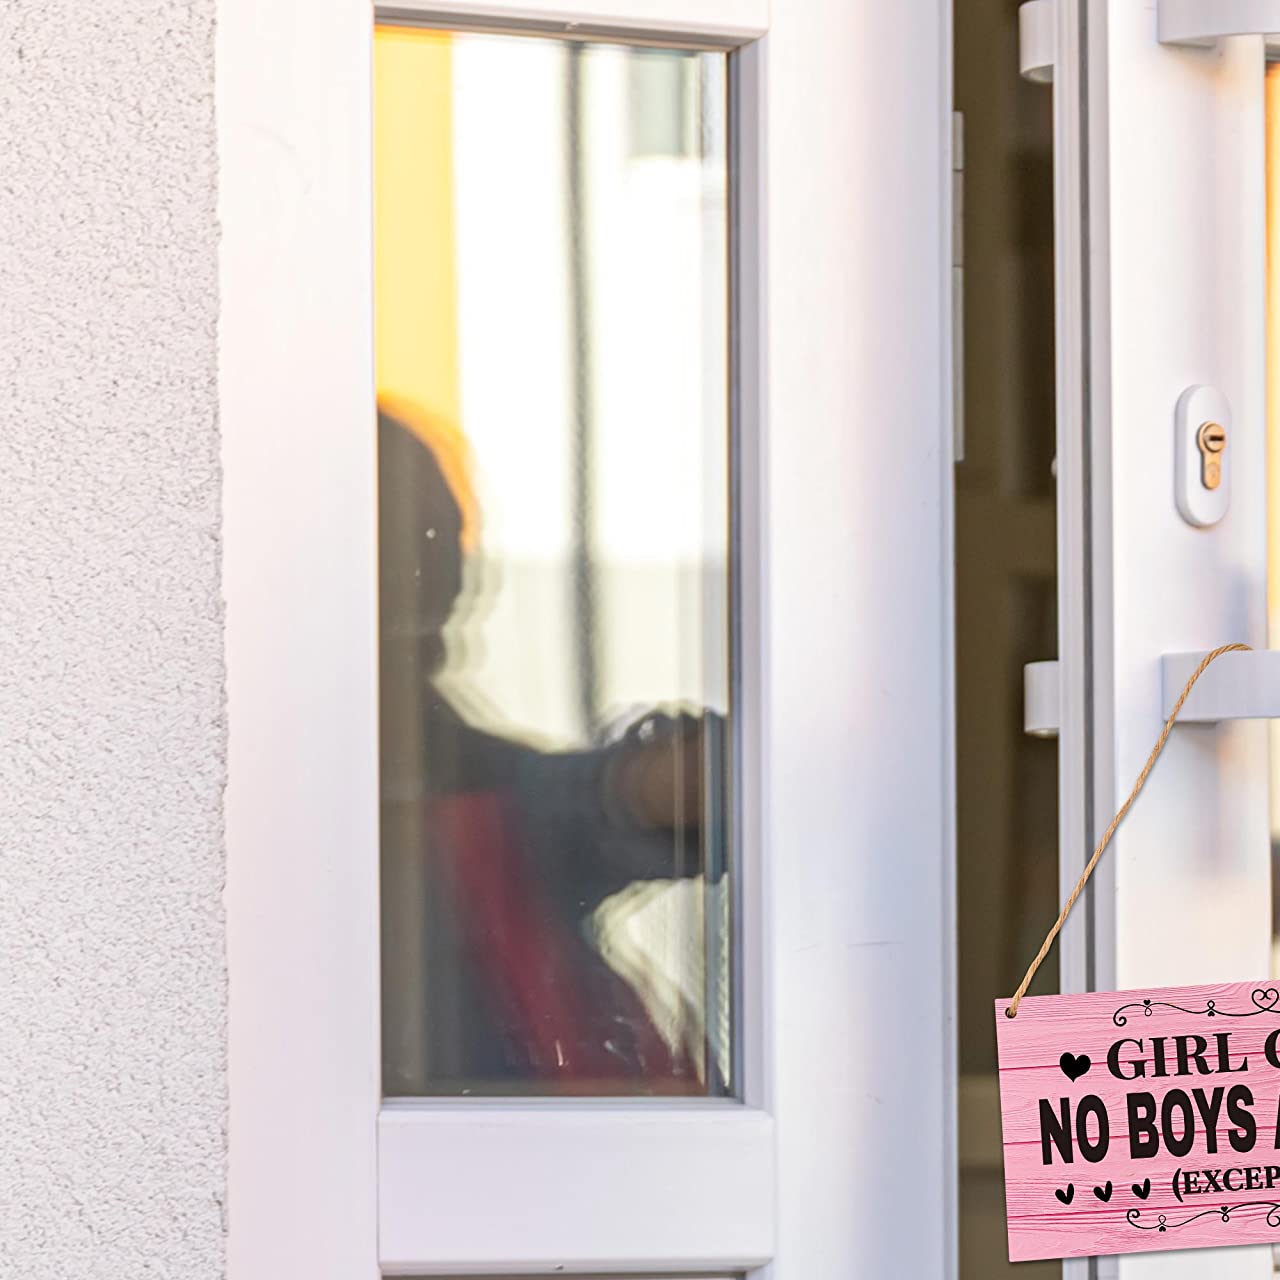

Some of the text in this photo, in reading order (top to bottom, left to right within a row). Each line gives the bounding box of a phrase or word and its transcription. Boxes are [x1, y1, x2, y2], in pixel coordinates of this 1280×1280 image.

[1107, 1032, 1248, 1080] GIRL
[1039, 1094, 1110, 1165] NO
[1127, 1084, 1257, 1159] BOYS
